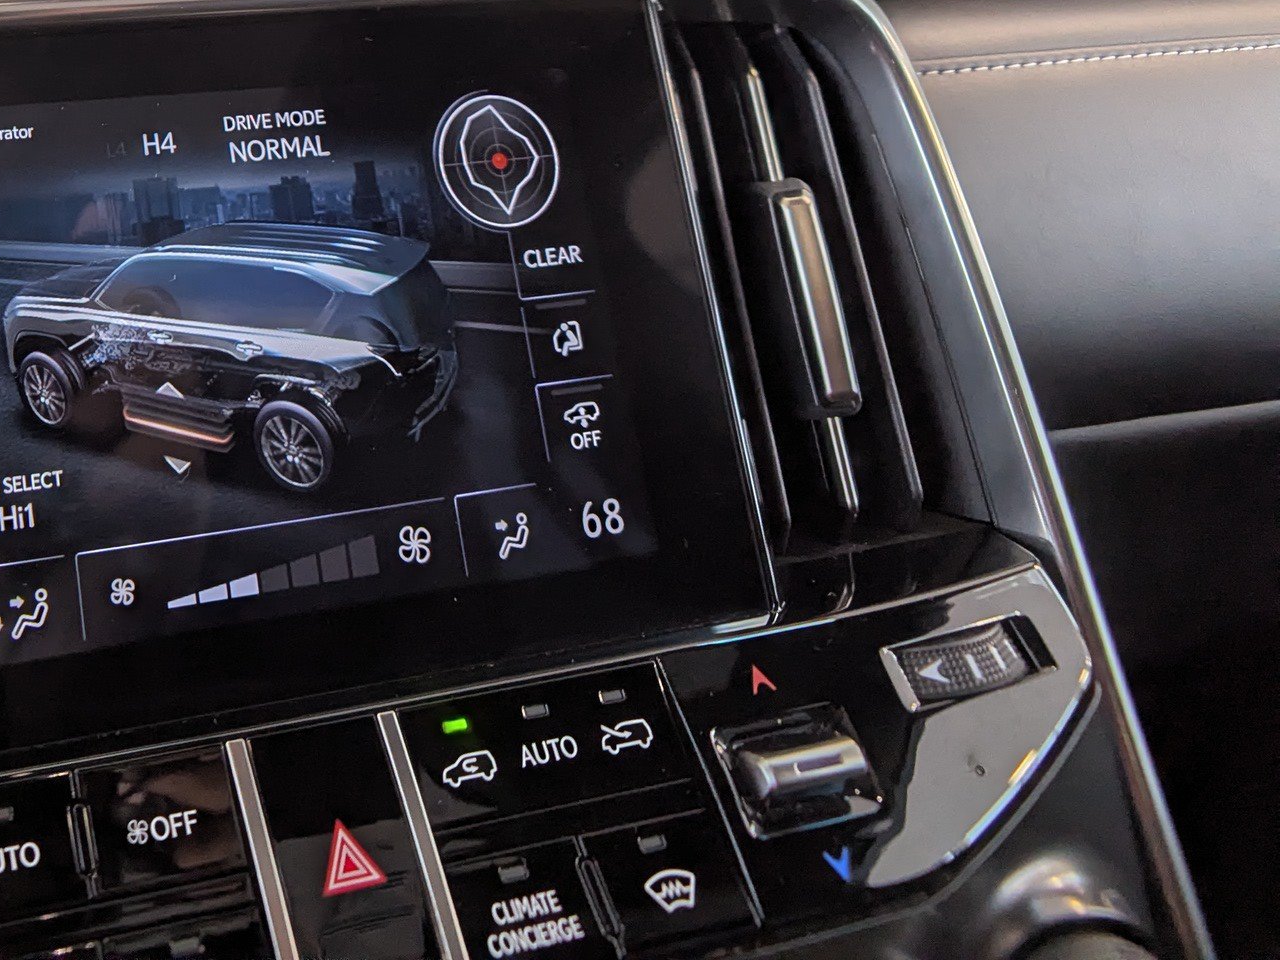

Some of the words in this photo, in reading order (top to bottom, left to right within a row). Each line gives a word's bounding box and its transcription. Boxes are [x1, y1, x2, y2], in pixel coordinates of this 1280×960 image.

[222, 113, 274, 132] DRIVE
[276, 109, 327, 128] MODE
[142, 131, 177, 157] H4
[229, 135, 331, 165] NORMAL
[523, 245, 584, 269] CLEAR
[570, 430, 602, 451] OFF
[2, 470, 64, 494] SELECT
[582, 497, 626, 539] 68
[521, 735, 578, 768] AUTO
[150, 809, 198, 841] OFF
[490, 889, 563, 926] CLIMATE
[486, 914, 586, 960] CONCIERGE
